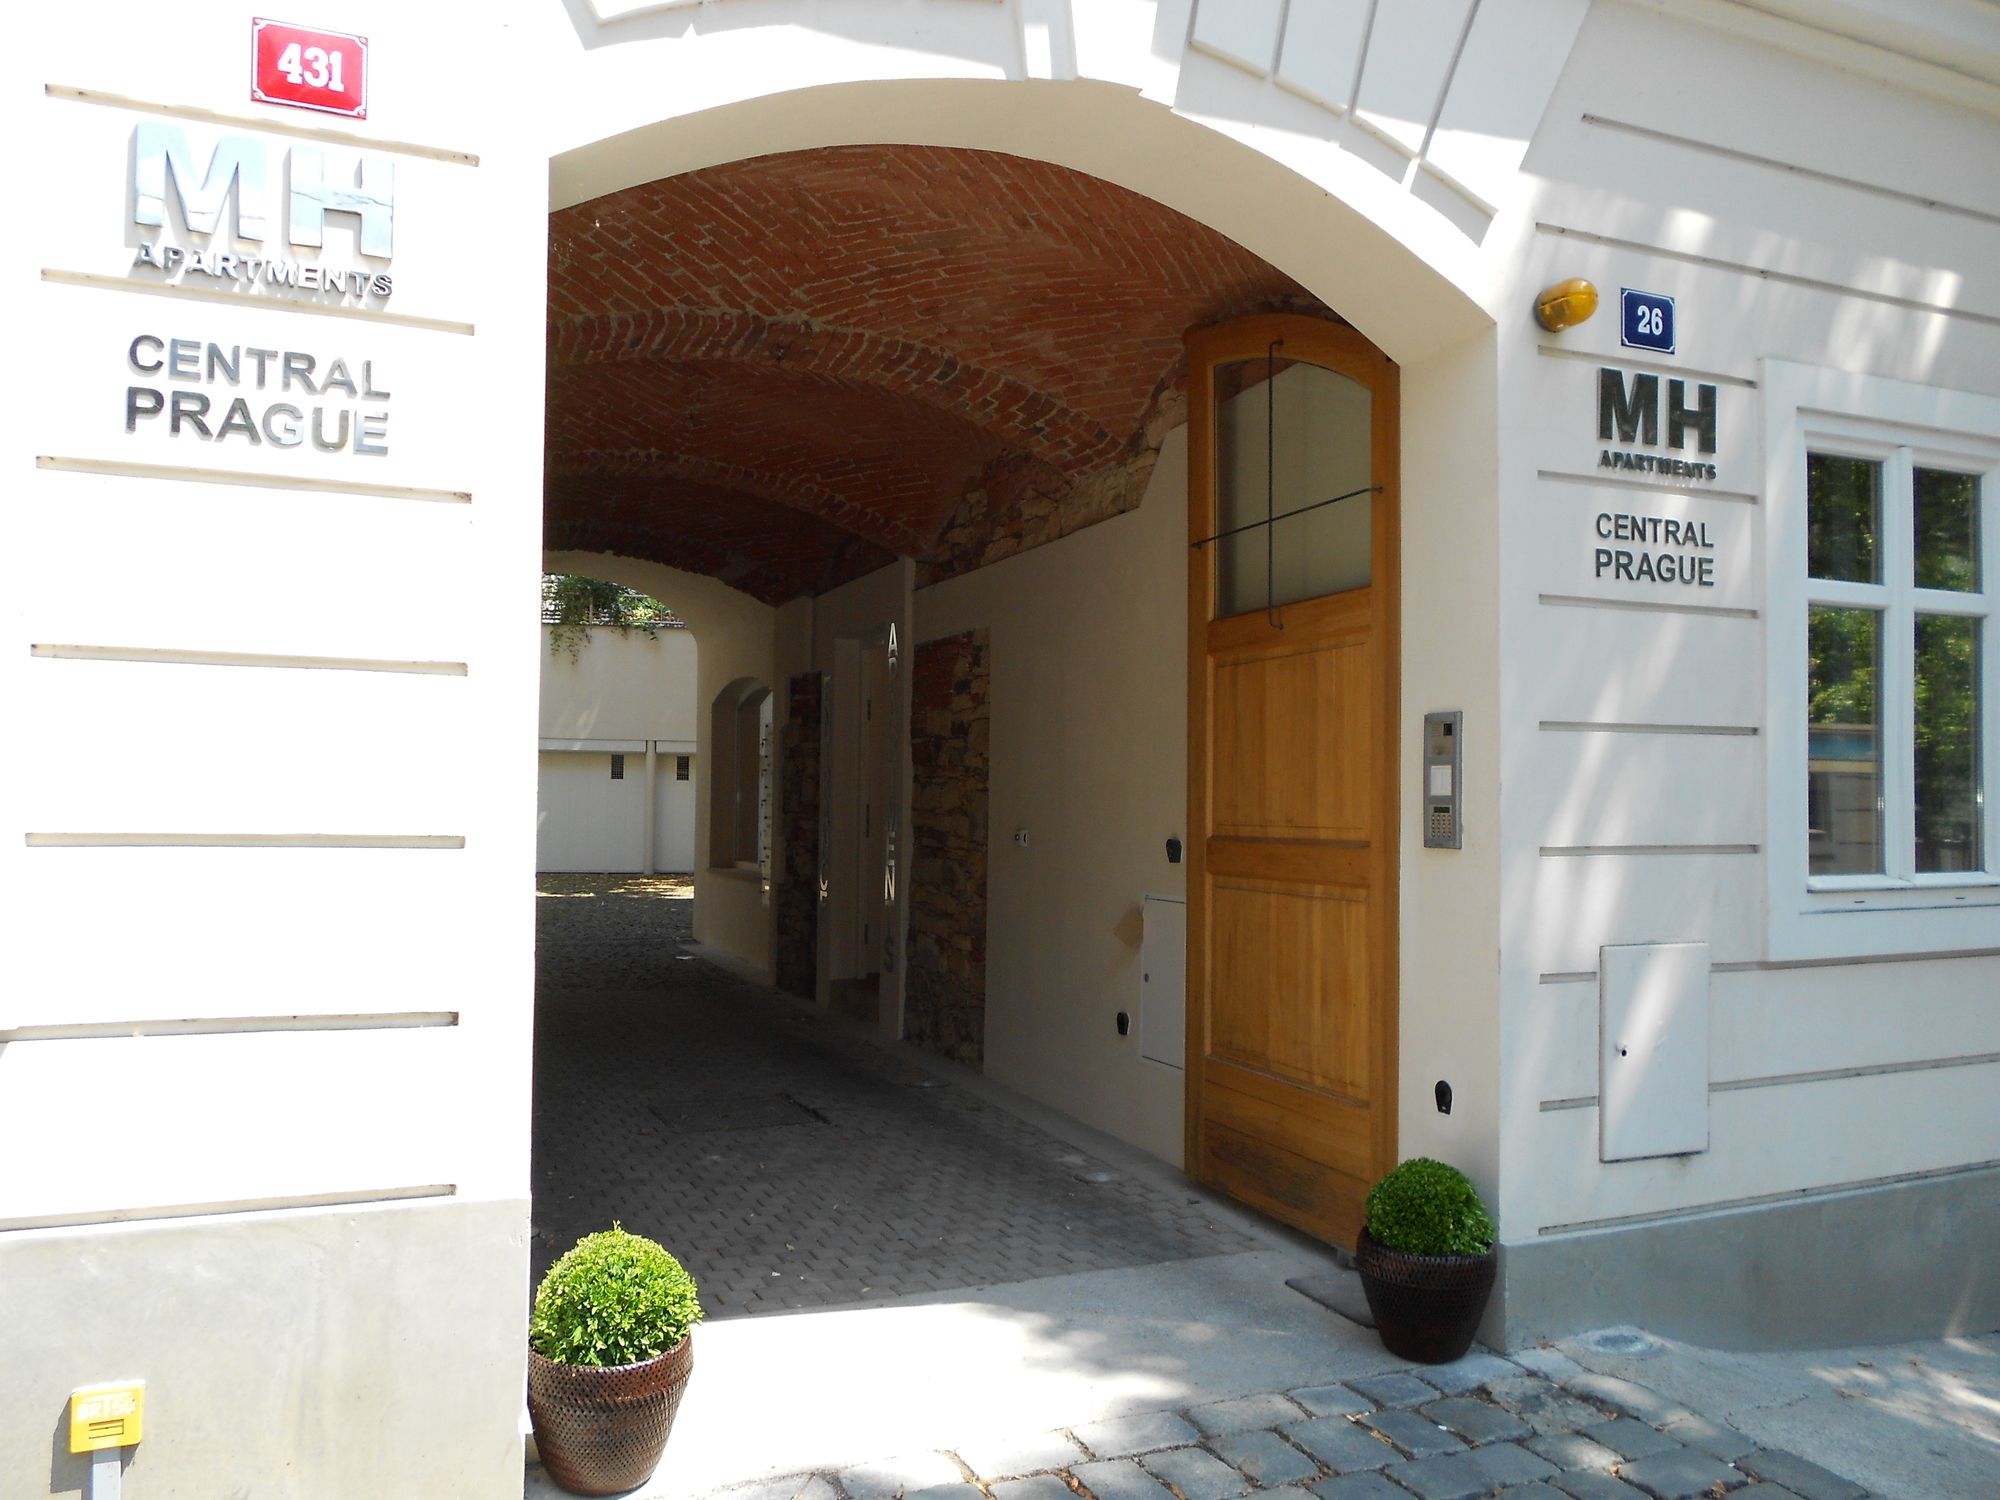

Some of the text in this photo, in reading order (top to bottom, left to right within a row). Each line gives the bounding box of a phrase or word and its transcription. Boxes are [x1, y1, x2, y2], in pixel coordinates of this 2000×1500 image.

[278, 43, 345, 92] 431
[132, 121, 395, 259] MH
[132, 241, 394, 298] APARTMENTS
[1637, 305, 1663, 336] 26
[128, 334, 391, 400] CENTRAL
[125, 385, 389, 456] PRAGUE
[1598, 367, 1717, 454] MH
[1598, 450, 1717, 480] APARTMENTS
[1596, 512, 1715, 549] CENTRAL
[1595, 548, 1715, 587] PRAGUE
